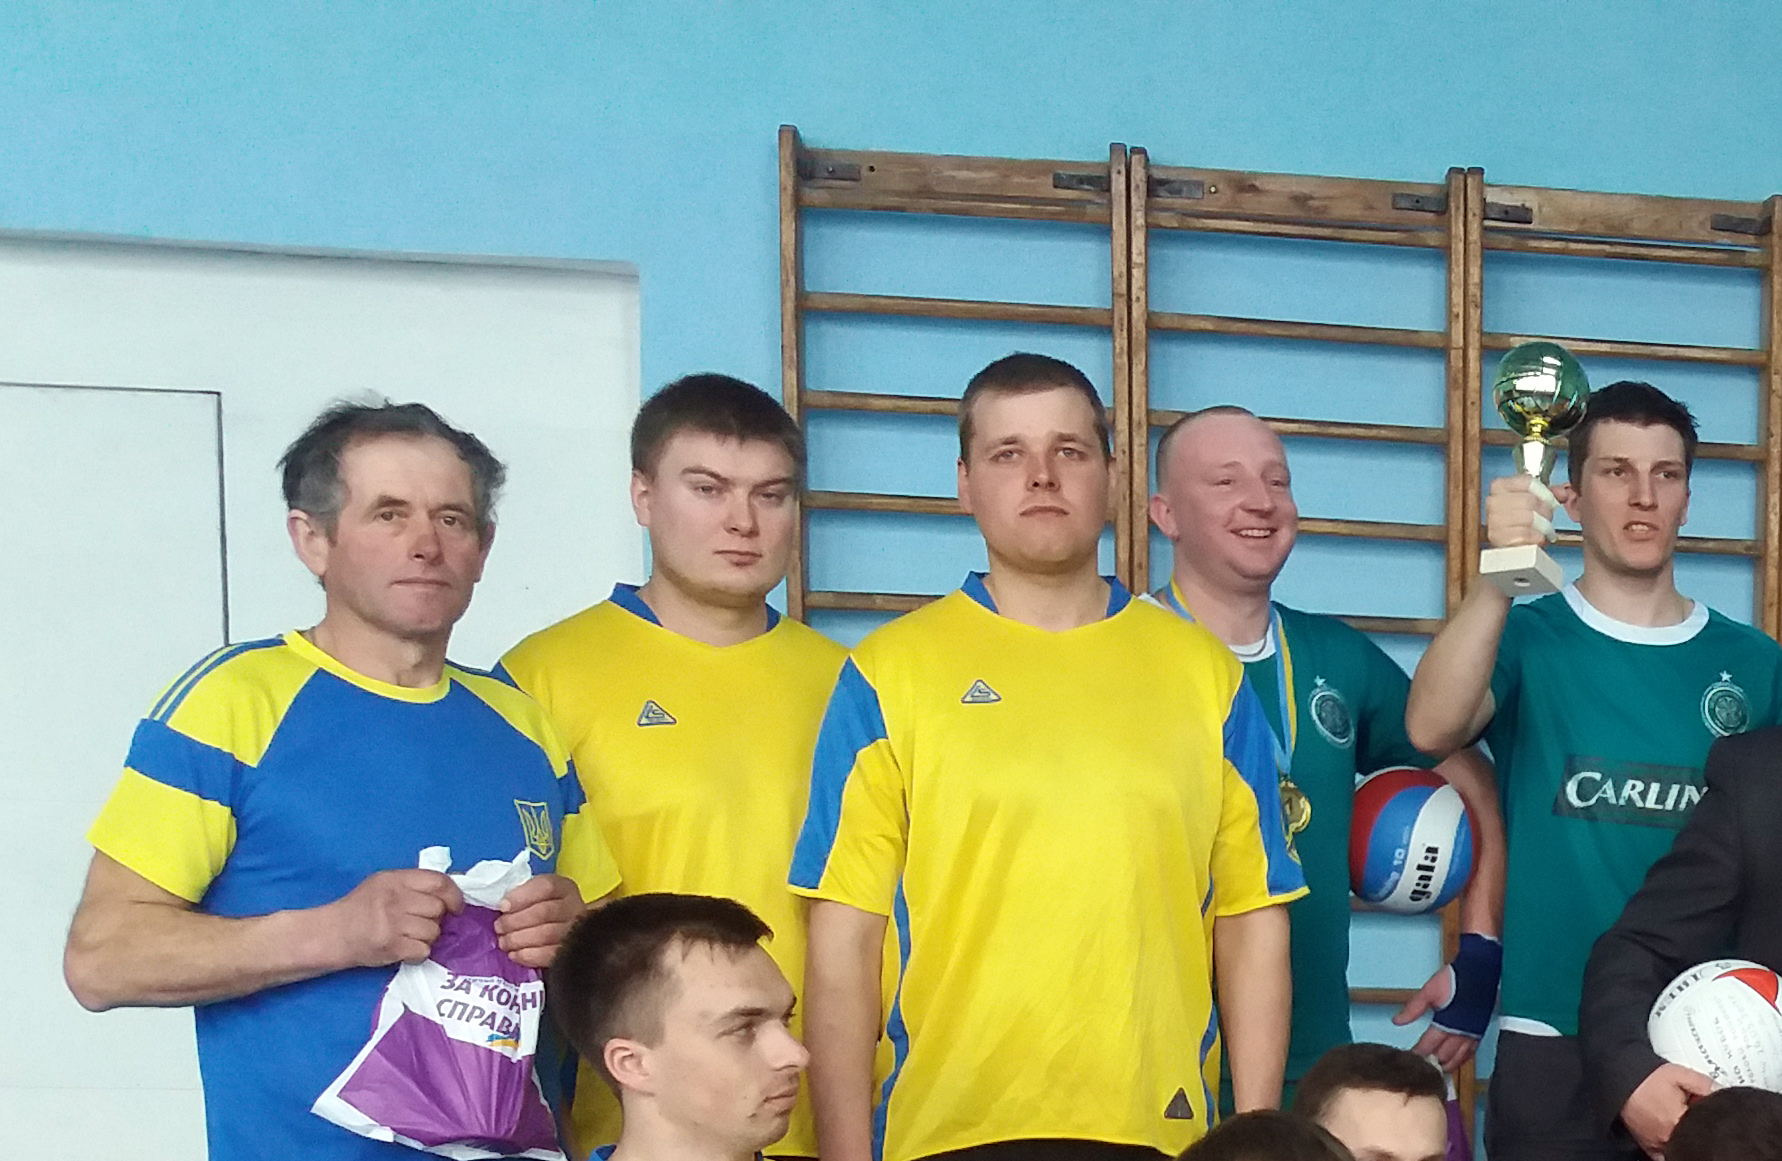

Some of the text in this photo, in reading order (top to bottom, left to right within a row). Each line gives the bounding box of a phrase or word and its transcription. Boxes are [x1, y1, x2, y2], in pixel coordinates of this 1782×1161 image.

[1566, 770, 1709, 812] CARLIN
[1409, 846, 1439, 902] gala
[440, 971, 472, 995] ЗА
